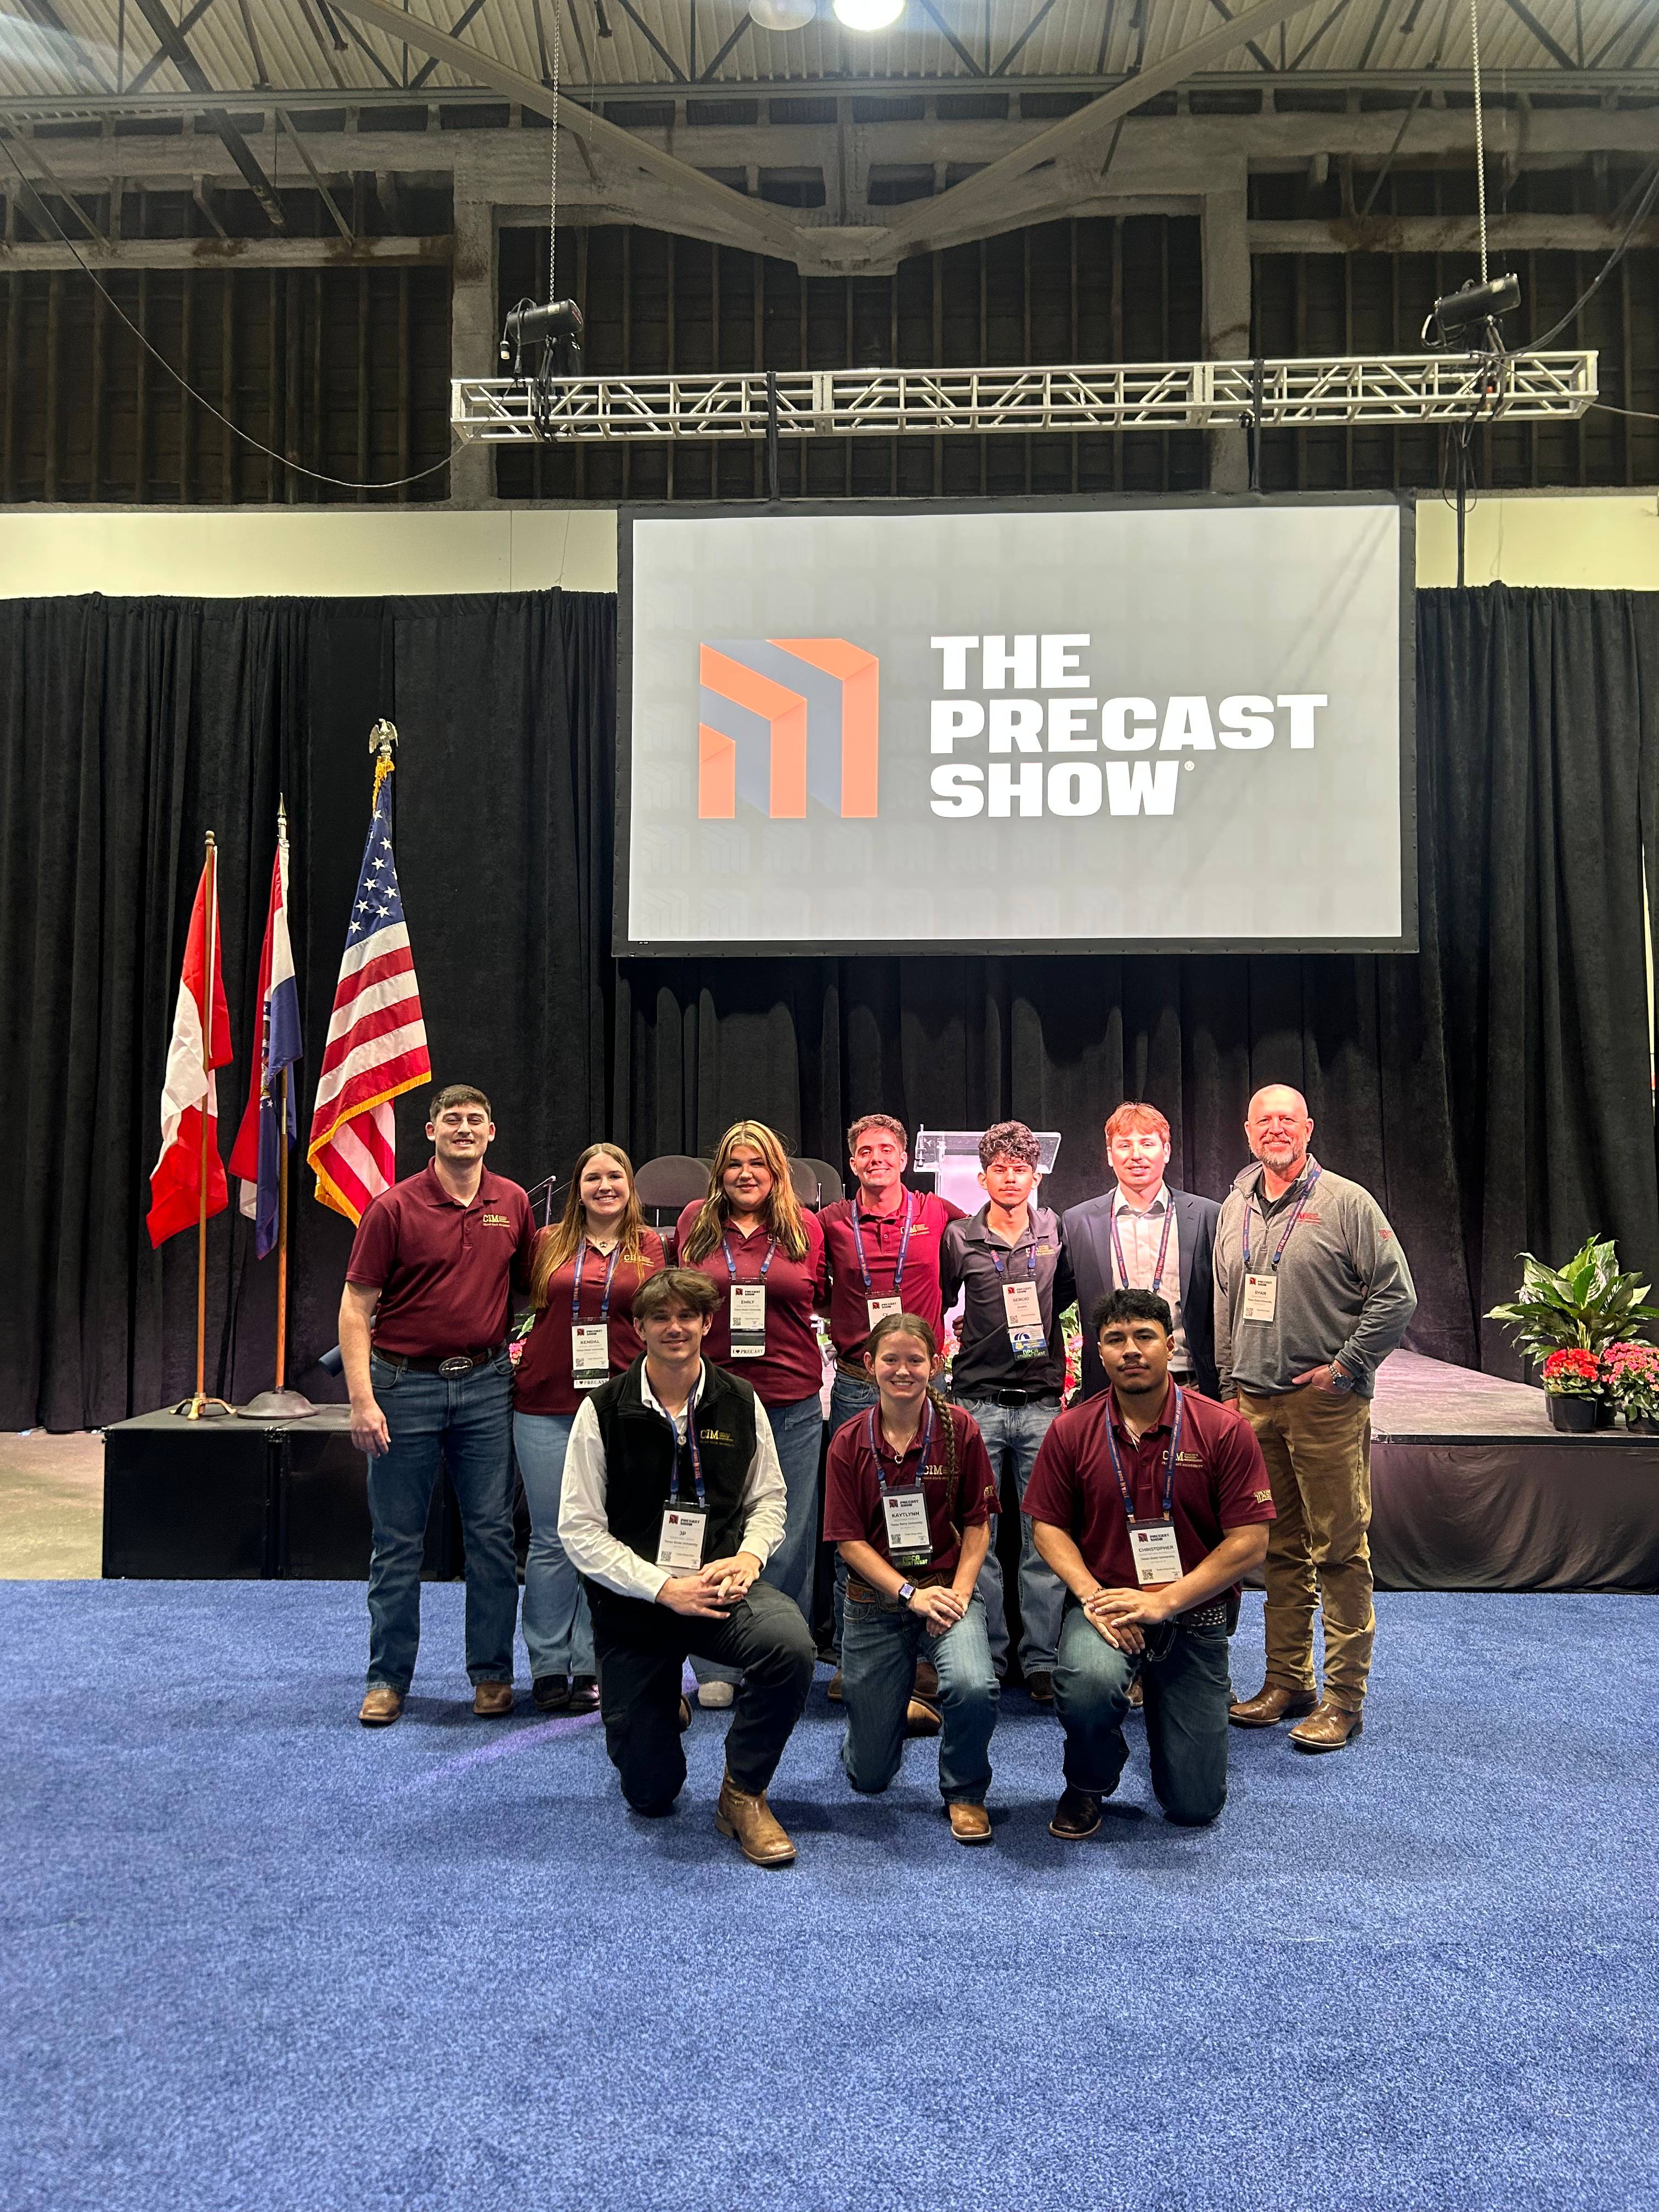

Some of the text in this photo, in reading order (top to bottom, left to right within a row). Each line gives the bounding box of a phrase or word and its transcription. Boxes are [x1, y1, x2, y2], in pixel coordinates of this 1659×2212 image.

[930, 634, 1090, 690] THE
[930, 694, 1328, 754] PRECAST
[930, 760, 1180, 818] SHOW
[483, 1214, 500, 1223] CIM
[701, 1429, 719, 1440] CIM
[1163, 1450, 1184, 1462] CM
